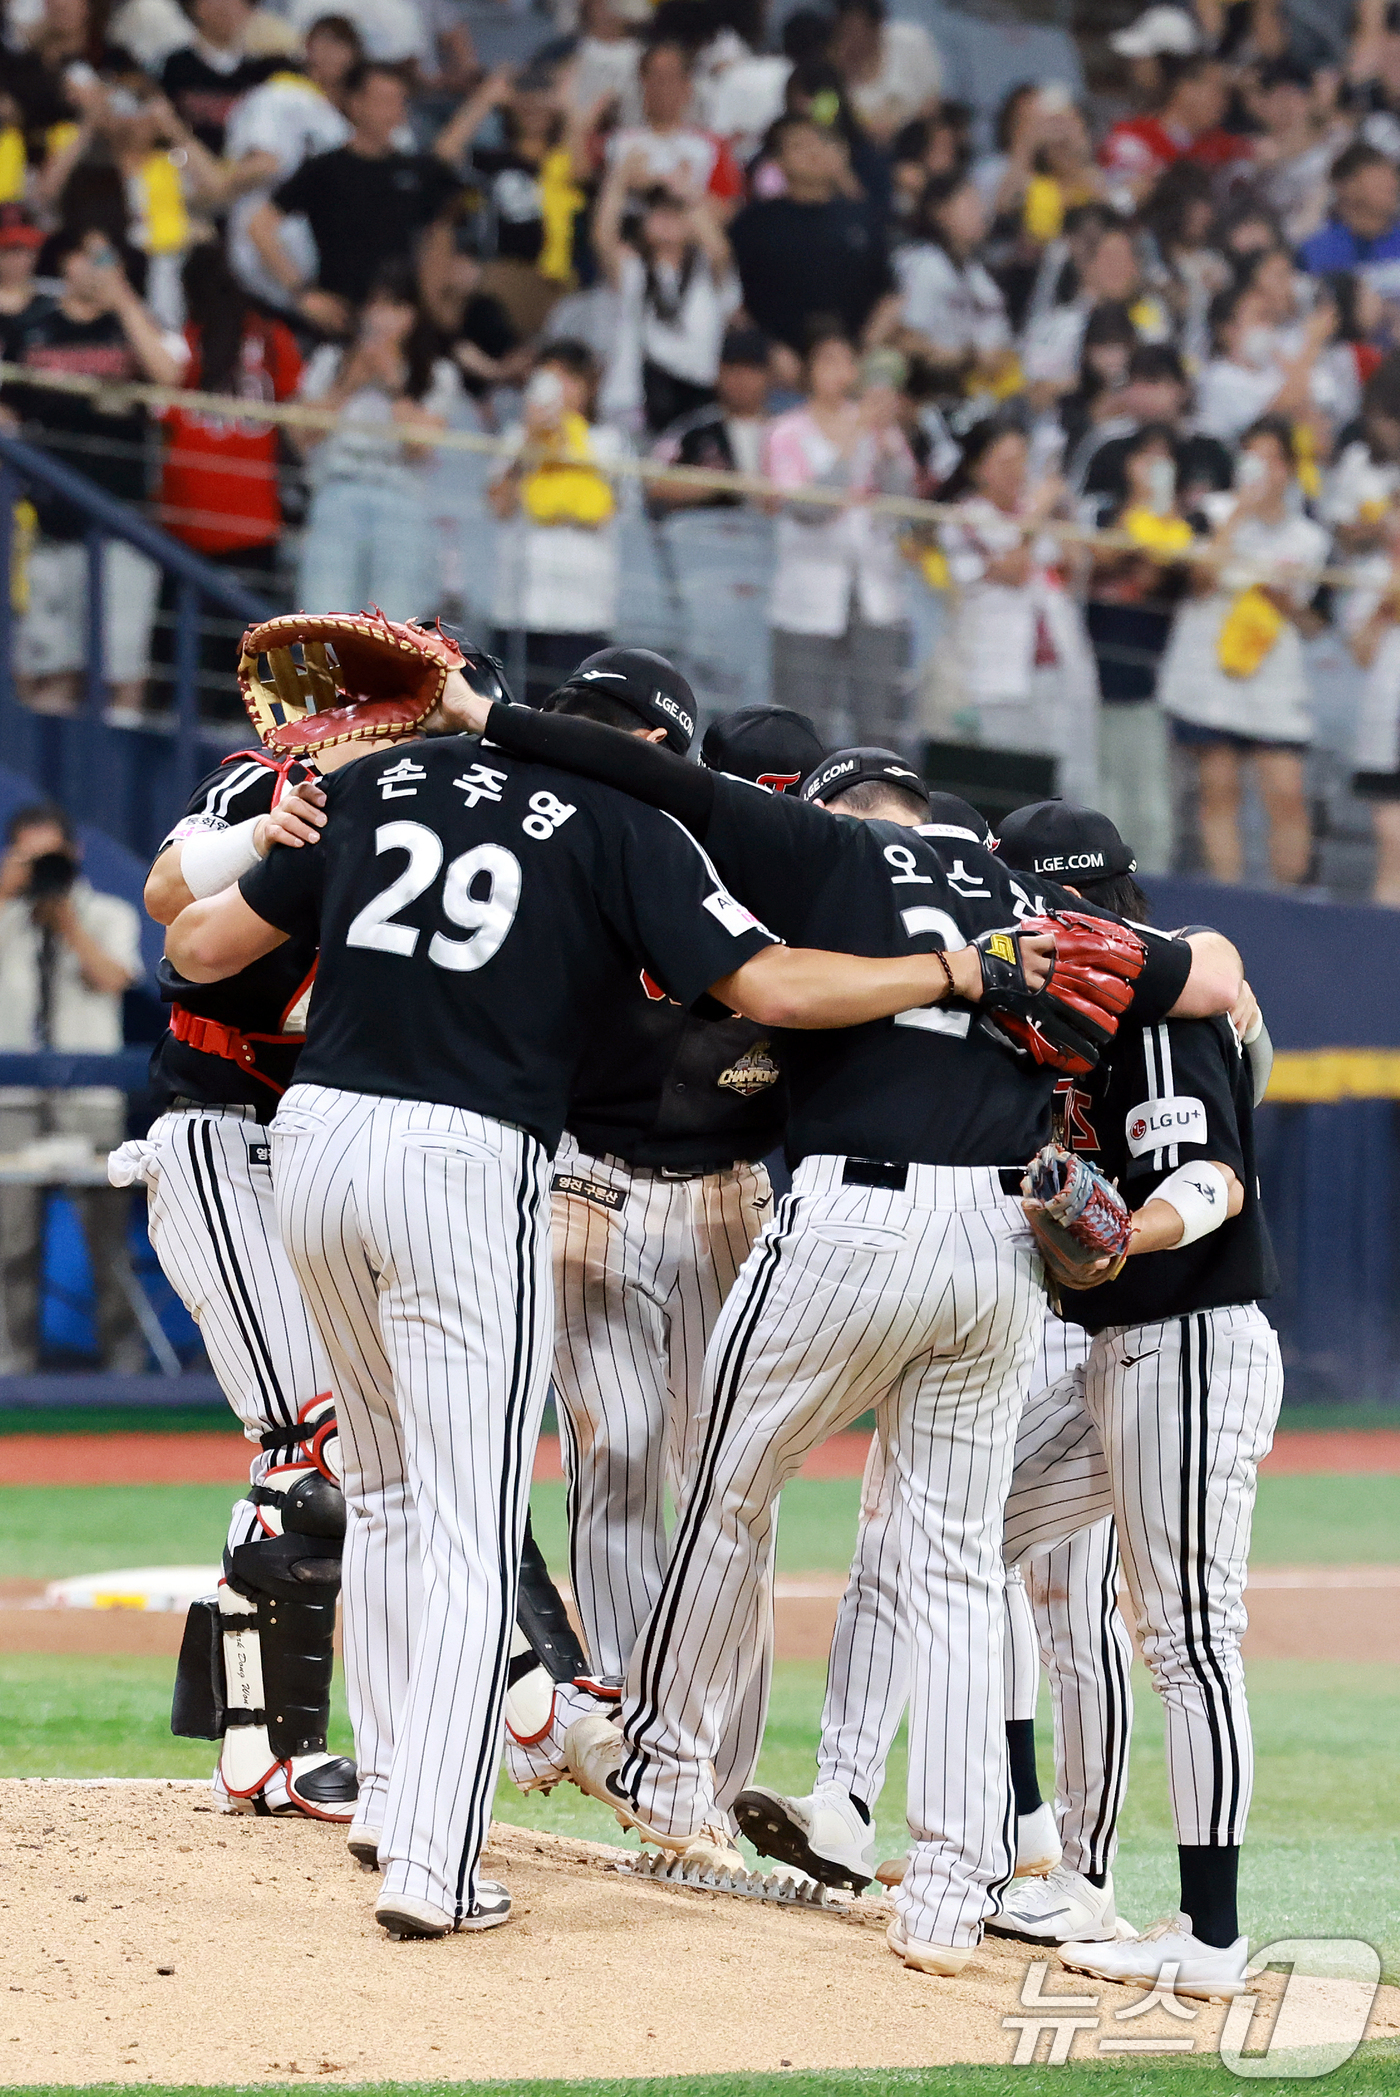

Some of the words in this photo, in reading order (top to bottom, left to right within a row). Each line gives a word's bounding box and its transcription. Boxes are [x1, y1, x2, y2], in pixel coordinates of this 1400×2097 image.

[803, 760, 854, 801] LGE.COM
[377, 758, 577, 841] 손주영
[1034, 853, 1104, 873] LGE.COM
[346, 820, 523, 972] 29
[1150, 1113, 1172, 1131] LG
[1176, 1109, 1201, 1125] U+
[559, 1177, 583, 1192] 영진
